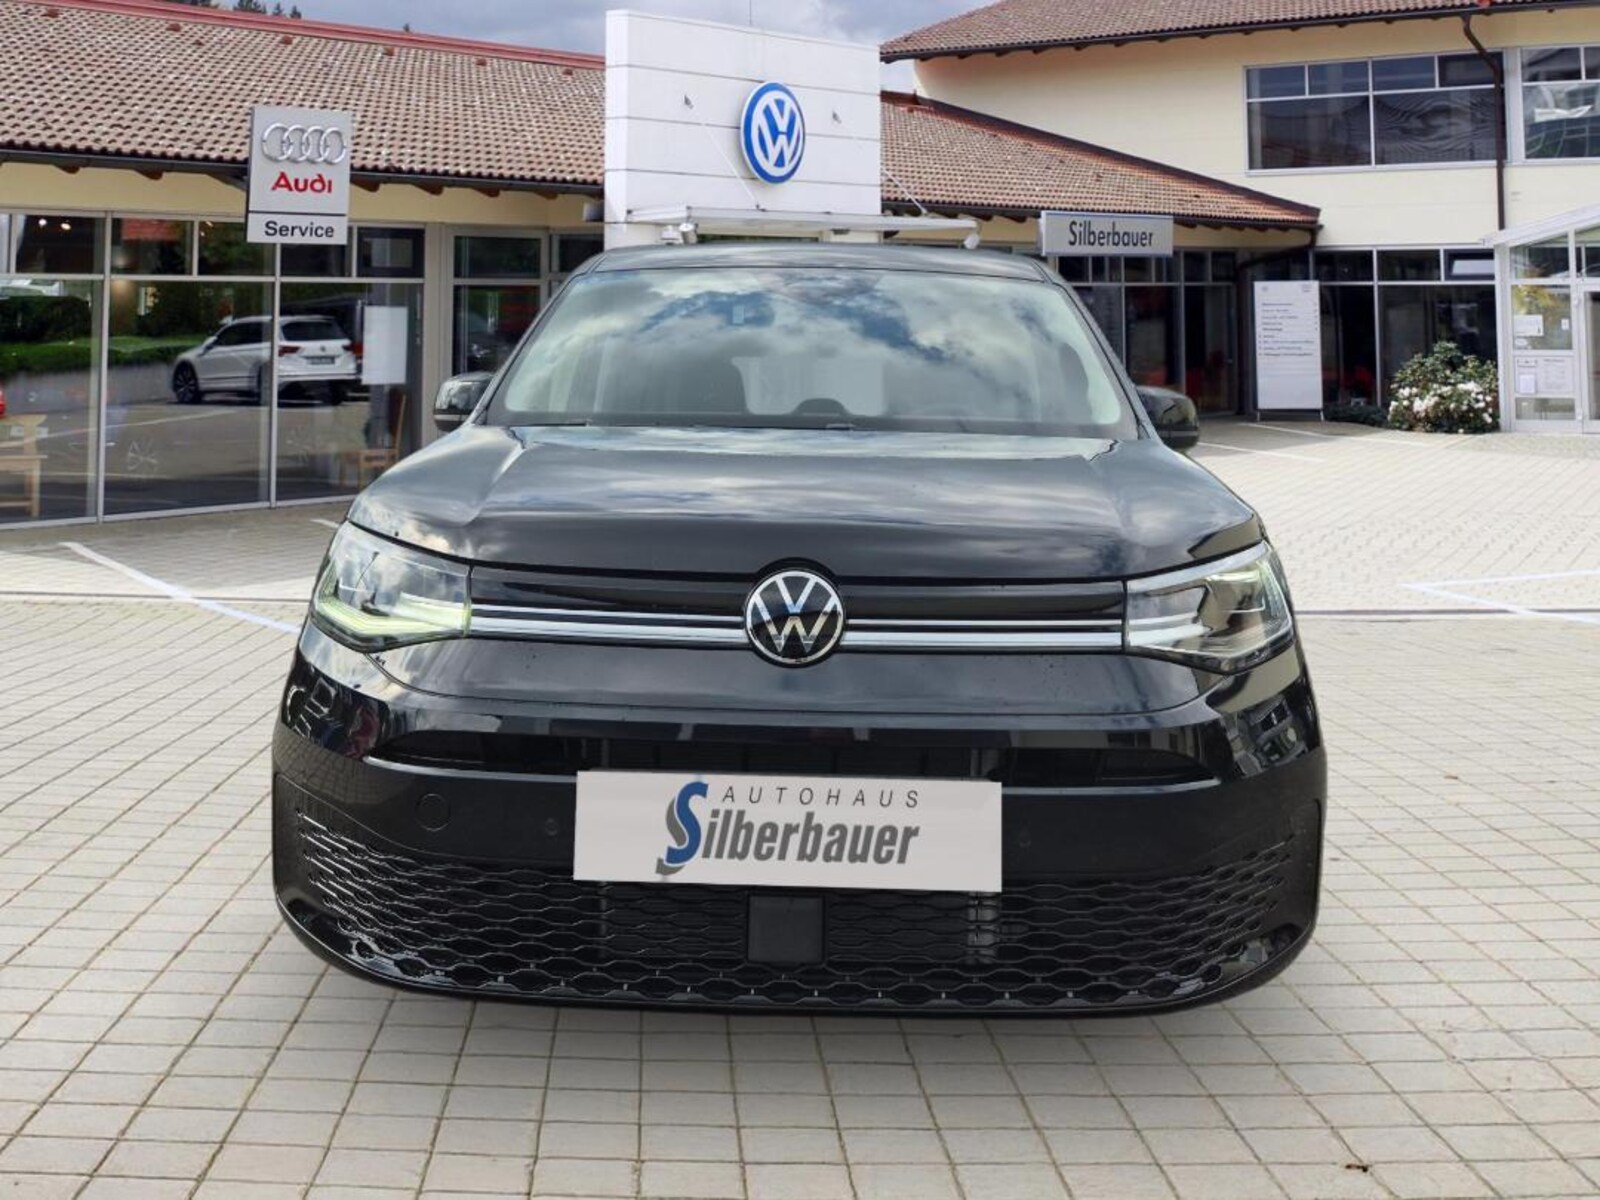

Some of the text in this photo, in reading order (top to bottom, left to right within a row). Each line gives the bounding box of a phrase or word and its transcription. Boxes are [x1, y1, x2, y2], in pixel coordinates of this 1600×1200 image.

[271, 171, 332, 194] Audi
[264, 220, 335, 238] Service
[1068, 219, 1154, 247] Silberbauer
[722, 786, 919, 808] AUTOHAUS
[655, 781, 920, 876] Silberbauer
